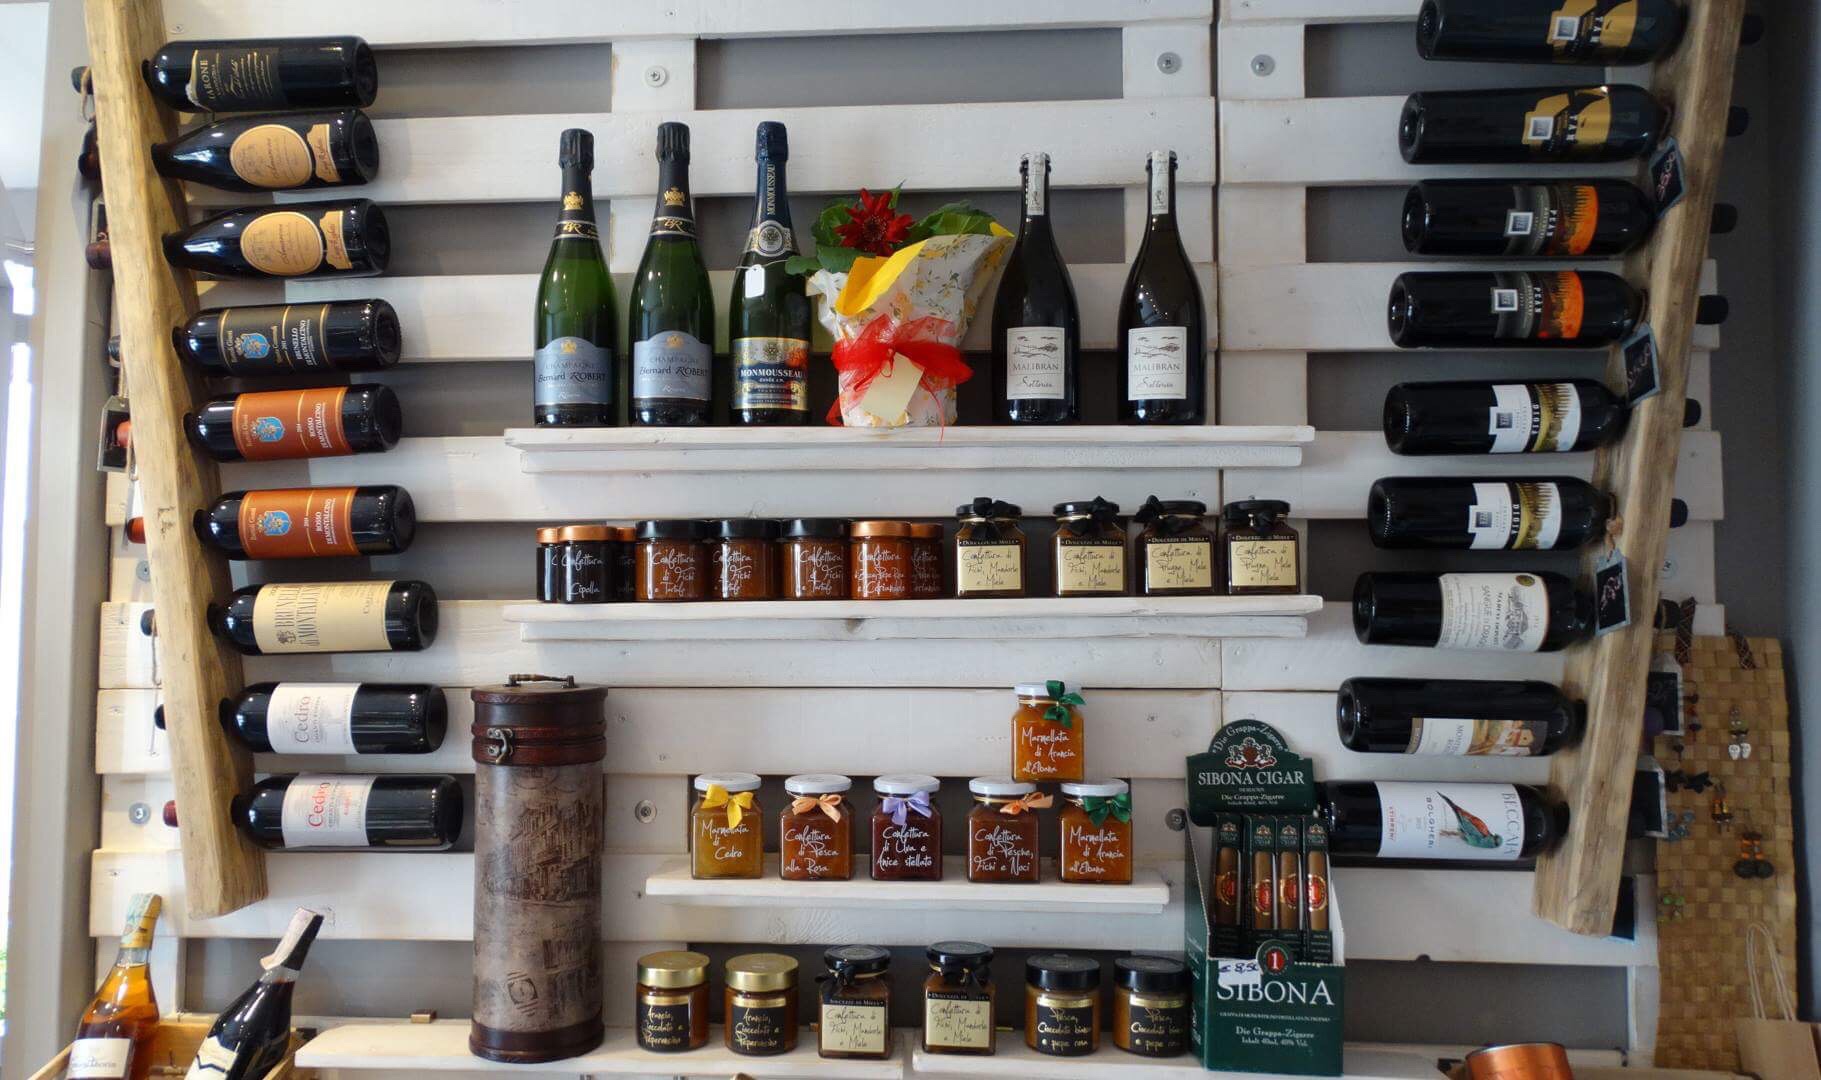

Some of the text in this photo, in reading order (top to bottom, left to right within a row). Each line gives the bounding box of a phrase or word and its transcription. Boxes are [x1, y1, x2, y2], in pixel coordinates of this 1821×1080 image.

[561, 549, 603, 571] Cnfettura
[652, 548, 695, 569] Confettura
[713, 547, 752, 566] Cofettura
[800, 546, 842, 568] Confettura
[858, 544, 902, 568] Cnfettura
[674, 566, 696, 583] Fichi
[730, 564, 752, 581] Fichi
[822, 564, 844, 580] Fichi
[570, 581, 600, 599] Cipolla
[274, 586, 300, 628] BRUNELL
[296, 586, 320, 638] MONTALCIN
[295, 696, 312, 744] Cedro
[1022, 726, 1069, 746] Marmellata
[1034, 743, 1076, 762] di Arancia
[1198, 770, 1305, 786] SIBONA CIGAR
[308, 782, 332, 828] Cedro
[1426, 797, 1436, 848] BOLGHERI
[712, 836, 720, 846] di
[784, 825, 831, 848] Confettura
[882, 823, 930, 843] Confettura
[974, 825, 1023, 847] Confettura
[1069, 825, 1119, 846] Marmellata
[715, 846, 743, 861] Cedro
[798, 841, 840, 858] di Pesca
[882, 839, 890, 851] di
[895, 838, 916, 854] Uva
[987, 843, 994, 856] di
[1082, 842, 1124, 863] di Arancia
[785, 857, 830, 874] alla Rosa
[877, 851, 932, 871] Anice stellato
[973, 855, 997, 873] Fichi
[1010, 855, 1030, 876] Noci
[1271, 952, 1279, 970] 1
[1217, 979, 1335, 1006] SIBONA
[1235, 1025, 1250, 1035] Die
